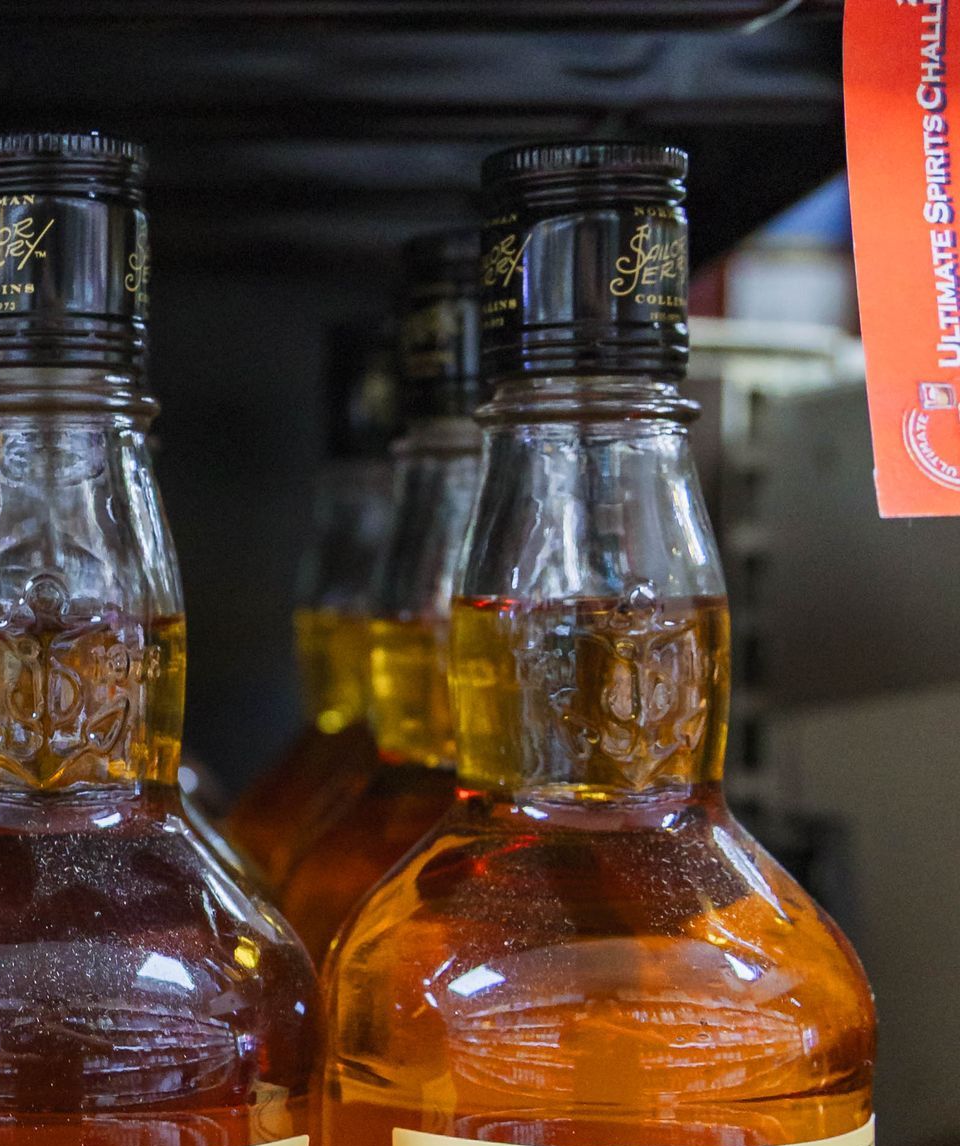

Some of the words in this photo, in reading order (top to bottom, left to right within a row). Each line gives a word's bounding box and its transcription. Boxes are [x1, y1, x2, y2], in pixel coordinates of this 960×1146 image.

[916, 0, 945, 111] CHALL
[922, 115, 951, 225] SPIRITS
[930, 229, 960, 368] ULTIMATE
